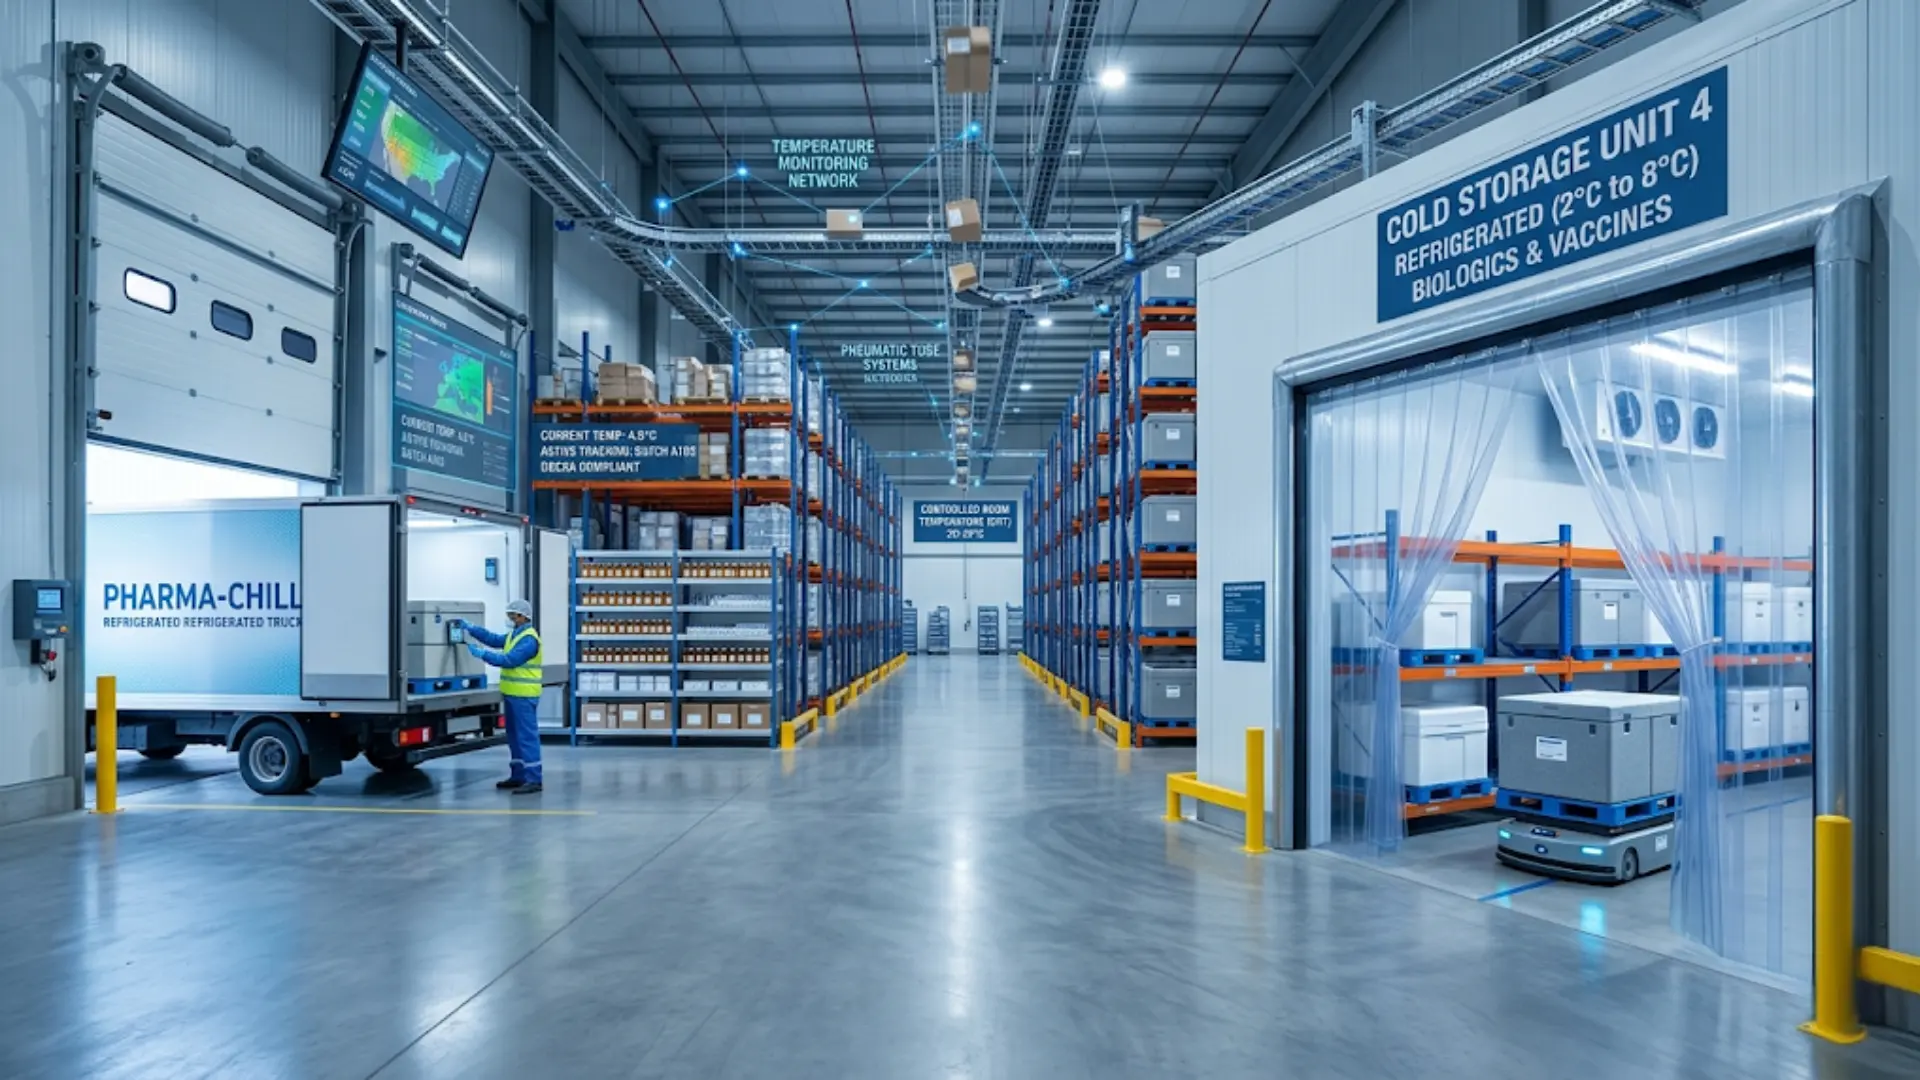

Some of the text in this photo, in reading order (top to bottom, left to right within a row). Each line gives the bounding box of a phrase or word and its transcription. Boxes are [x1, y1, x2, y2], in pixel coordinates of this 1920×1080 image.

[1386, 86, 1713, 245] COLD STORAGE UNIT 4
[1395, 144, 1700, 277] REFRIGERATED (2°C to 8°C)
[1412, 193, 1673, 303] BIOLOGICS & VACCINES
[103, 582, 302, 610] PHARMA-CHILL
[103, 617, 180, 628] REFRIGERATED
[183, 617, 264, 628] REFRIGERATED
